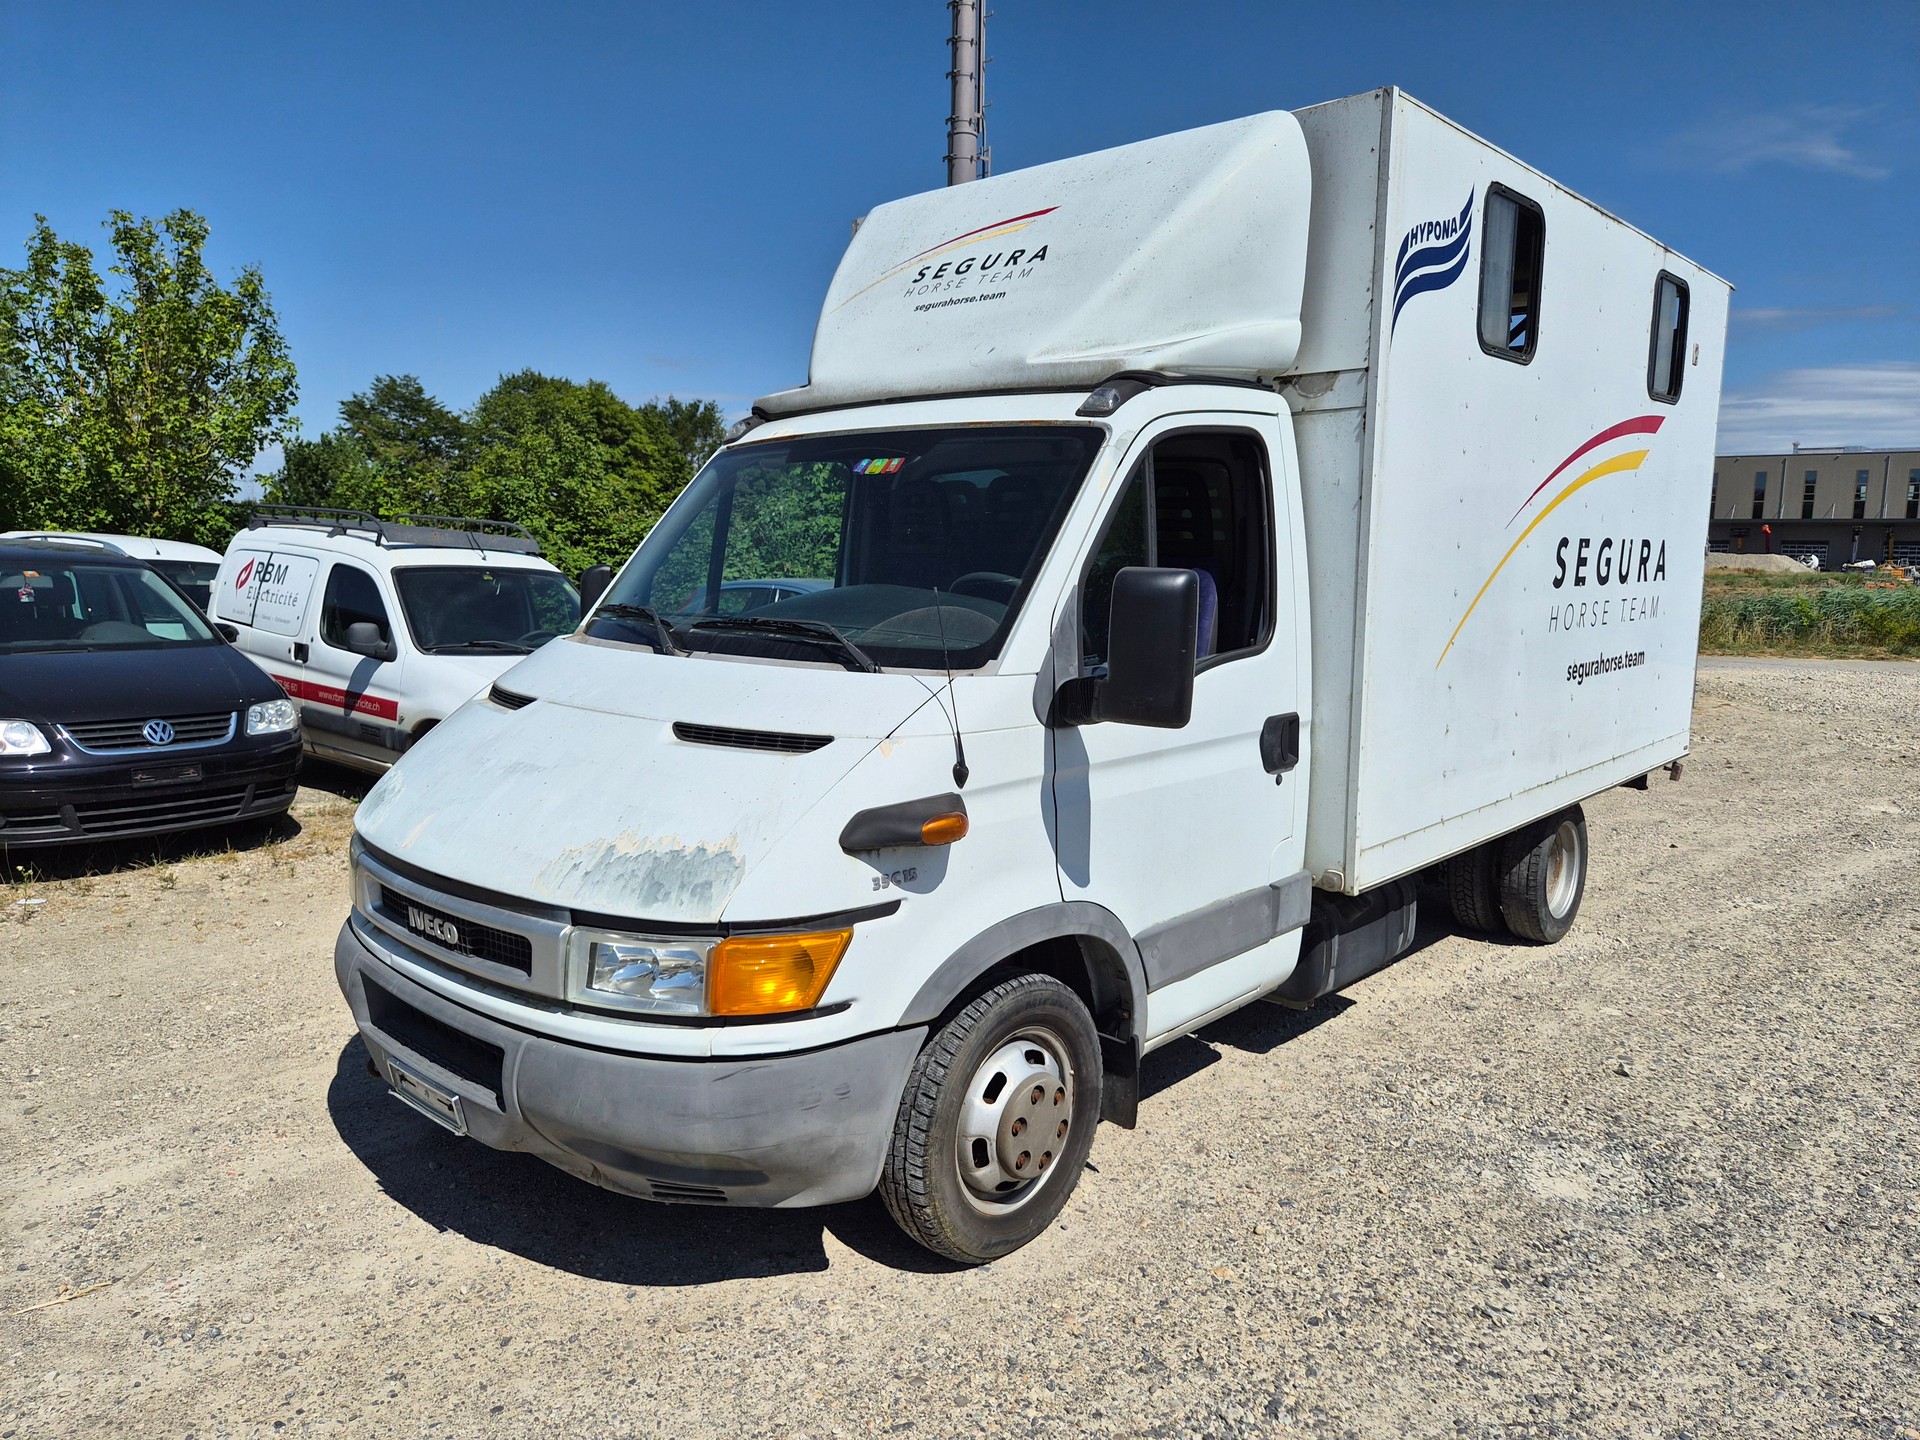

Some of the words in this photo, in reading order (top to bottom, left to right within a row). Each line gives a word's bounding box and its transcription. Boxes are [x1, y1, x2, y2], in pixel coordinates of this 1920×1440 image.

[1409, 217, 1458, 248] HYPONA
[912, 245, 1048, 284] SEGURA
[903, 277, 967, 298] HORSE
[978, 267, 1033, 285] TEAM
[913, 291, 1006, 312] segurahorse.team
[253, 561, 289, 586] RBM
[1552, 536, 1666, 589] SEGURA
[246, 586, 299, 607] Elctricité
[1548, 600, 1610, 633] HORSE
[1620, 595, 1660, 623] TEAM
[1566, 651, 1645, 686] segurahorse.team
[408, 906, 459, 945] IVECO
